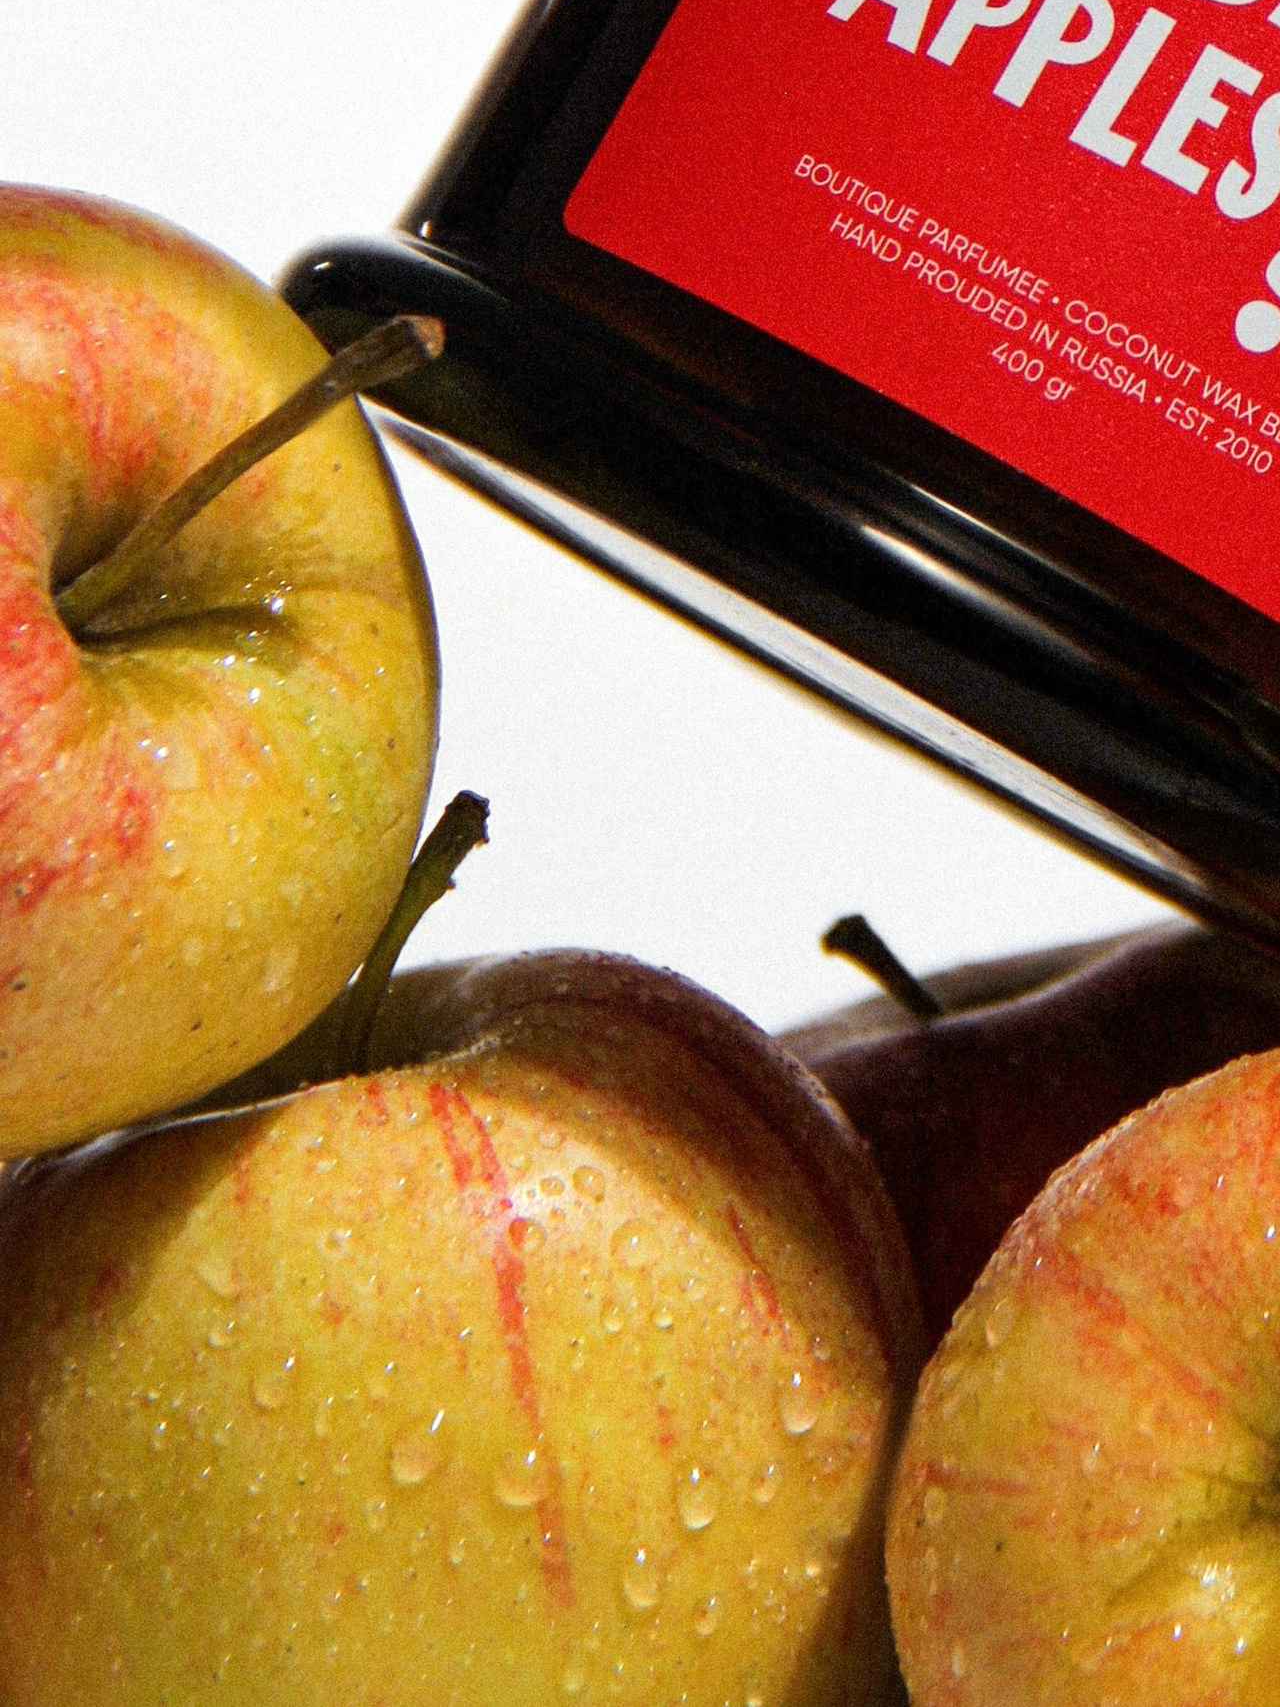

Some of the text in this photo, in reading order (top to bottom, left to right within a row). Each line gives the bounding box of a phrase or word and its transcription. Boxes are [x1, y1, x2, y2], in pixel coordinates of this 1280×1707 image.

[795, 154, 920, 233] BOUTIQUE
[919, 218, 1051, 304] PARFUMEE
[1065, 300, 1200, 387] COCONUT
[1202, 376, 1261, 426] WAX
[830, 215, 1273, 474] HAND PROUDED IN RUSSIA EST. 2010
[991, 343, 1076, 402] 400 gr
